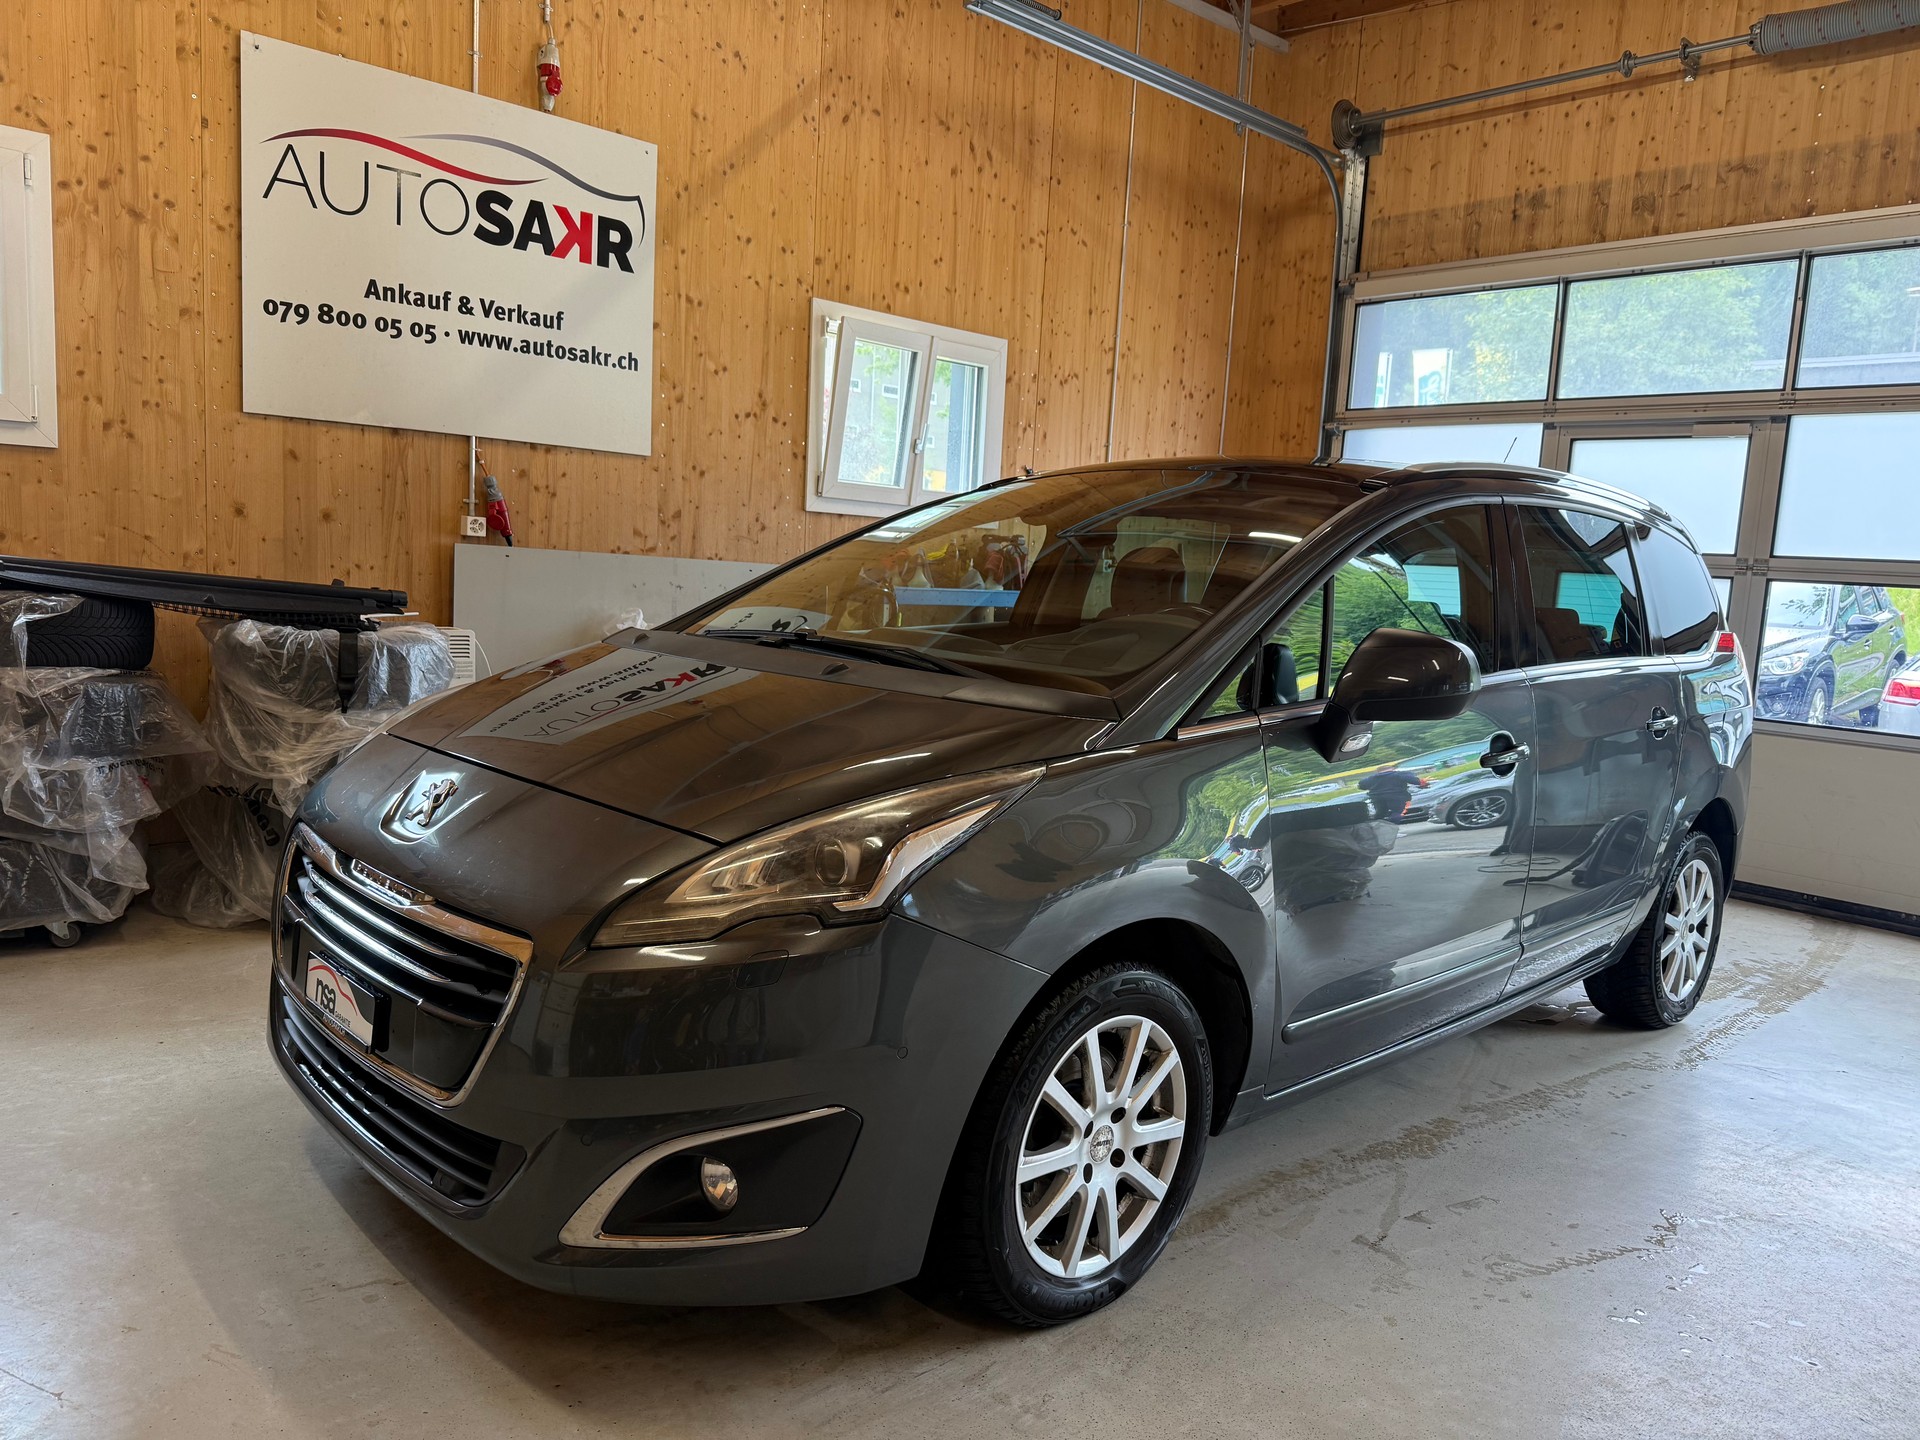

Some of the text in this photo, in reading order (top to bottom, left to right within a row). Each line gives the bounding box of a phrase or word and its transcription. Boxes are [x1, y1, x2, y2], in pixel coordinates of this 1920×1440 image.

[262, 143, 635, 274] AUTOSAKR
[262, 298, 310, 325] 079
[317, 303, 367, 329] 800
[374, 315, 403, 339] 05
[409, 321, 437, 344] 05
[457, 327, 640, 373] www.autosakr.ch
[363, 279, 565, 331] Ankauf & Verkauf
[315, 977, 337, 1016] nsa
[1020, 1010, 1077, 1096] POLARIS
